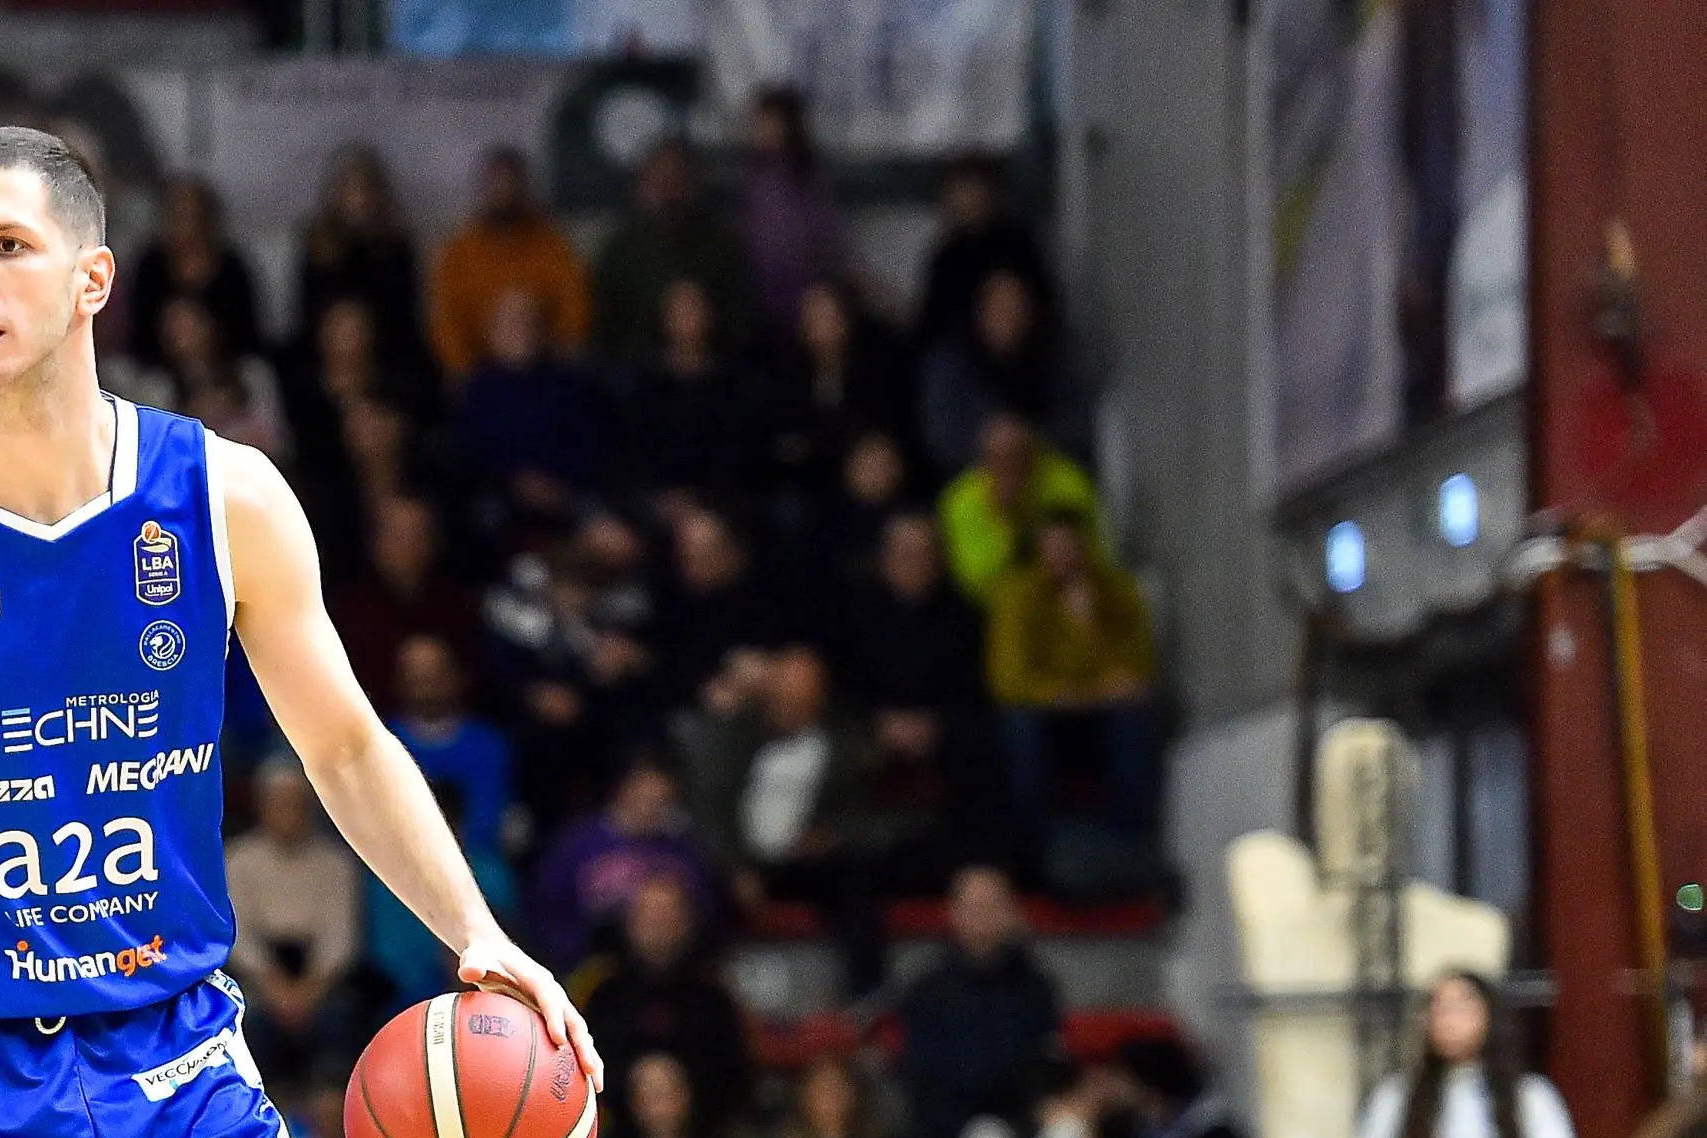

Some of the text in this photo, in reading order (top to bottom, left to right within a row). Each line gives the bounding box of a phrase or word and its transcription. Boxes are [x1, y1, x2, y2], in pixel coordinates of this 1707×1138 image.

[142, 556, 173, 571] LBA
[147, 582, 173, 596] Unipol
[66, 689, 160, 708] METROLOGIA
[49, 891, 159, 924] COMPANY
